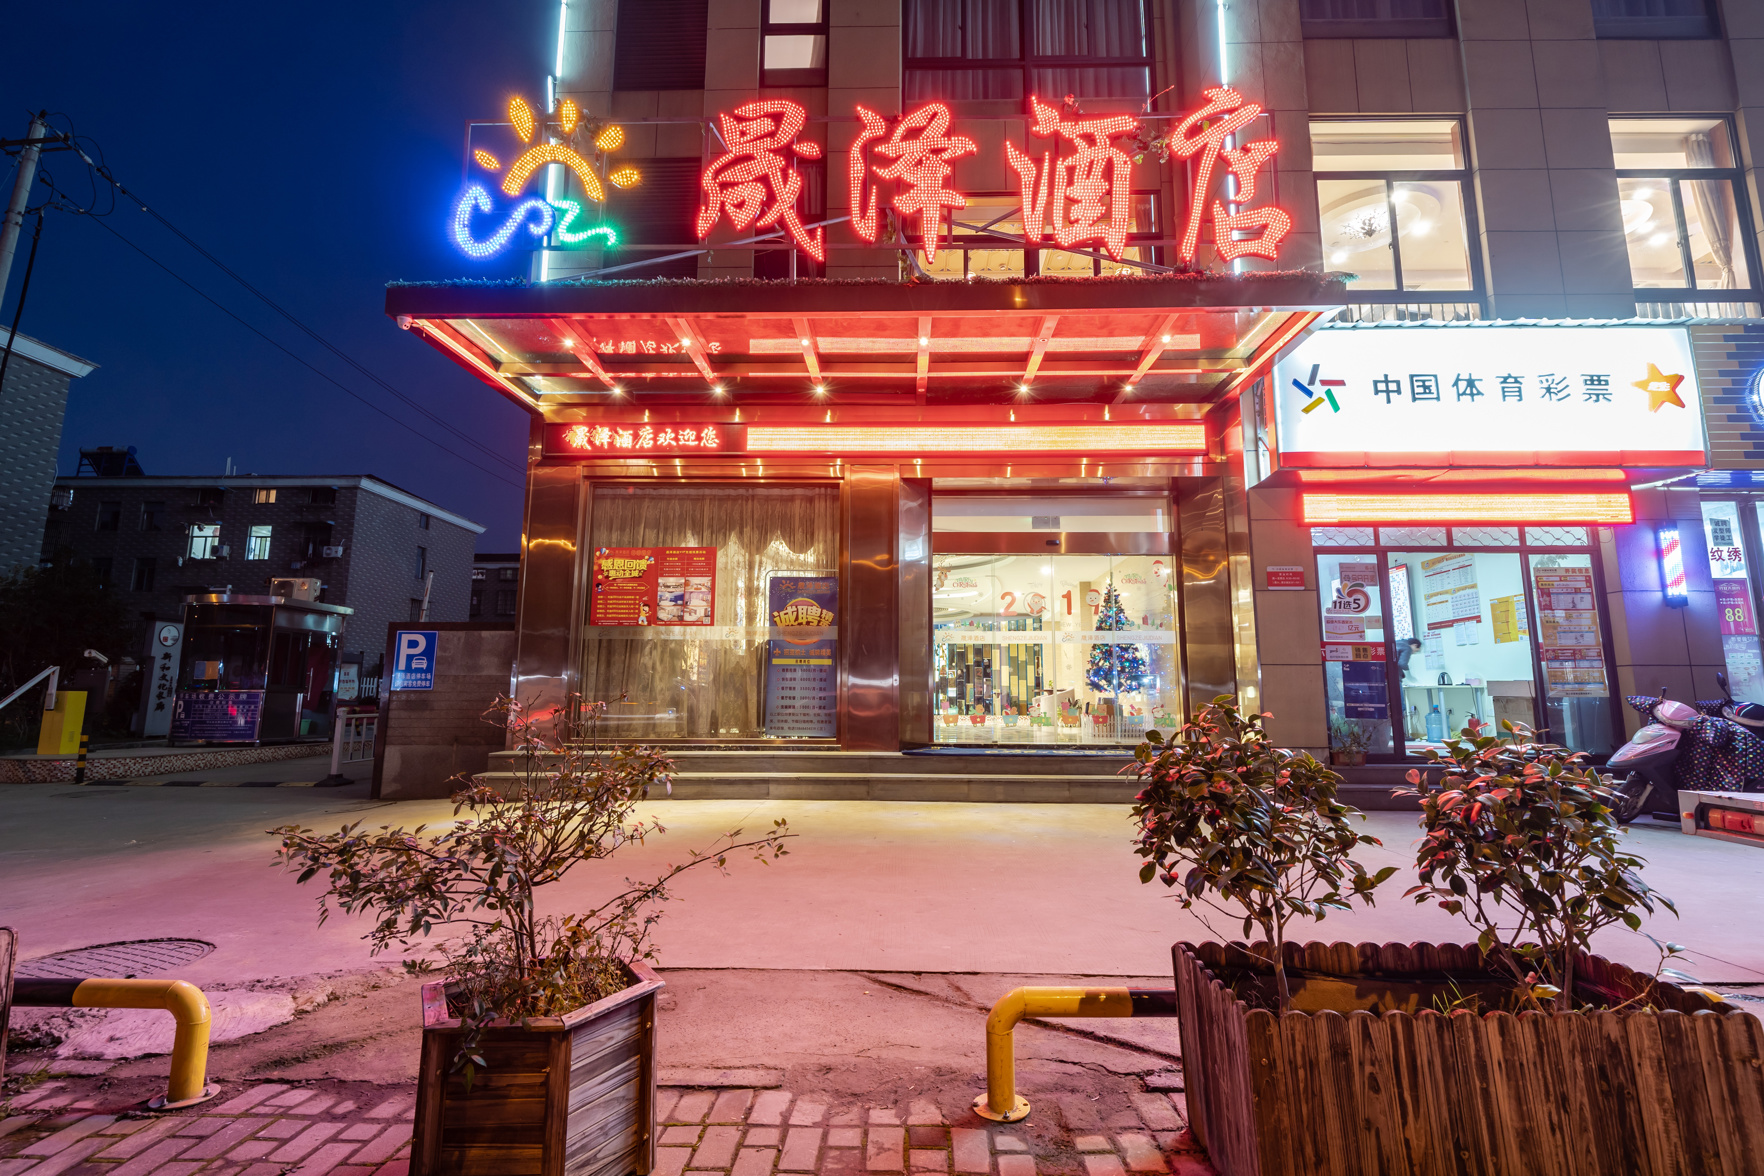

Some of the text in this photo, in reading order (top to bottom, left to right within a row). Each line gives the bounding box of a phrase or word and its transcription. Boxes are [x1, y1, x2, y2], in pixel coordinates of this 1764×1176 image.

[695, 87, 1293, 265] 晟泽酒店
[1371, 373, 1614, 405] 中国体育彩票
[601, 558, 648, 571] 感恩回馈
[1710, 547, 1742, 562] 纹绣
[1332, 598, 1361, 610] 11选5
[772, 605, 822, 630] 诚聘
[1724, 607, 1744, 622] 88
[398, 633, 427, 671] P
